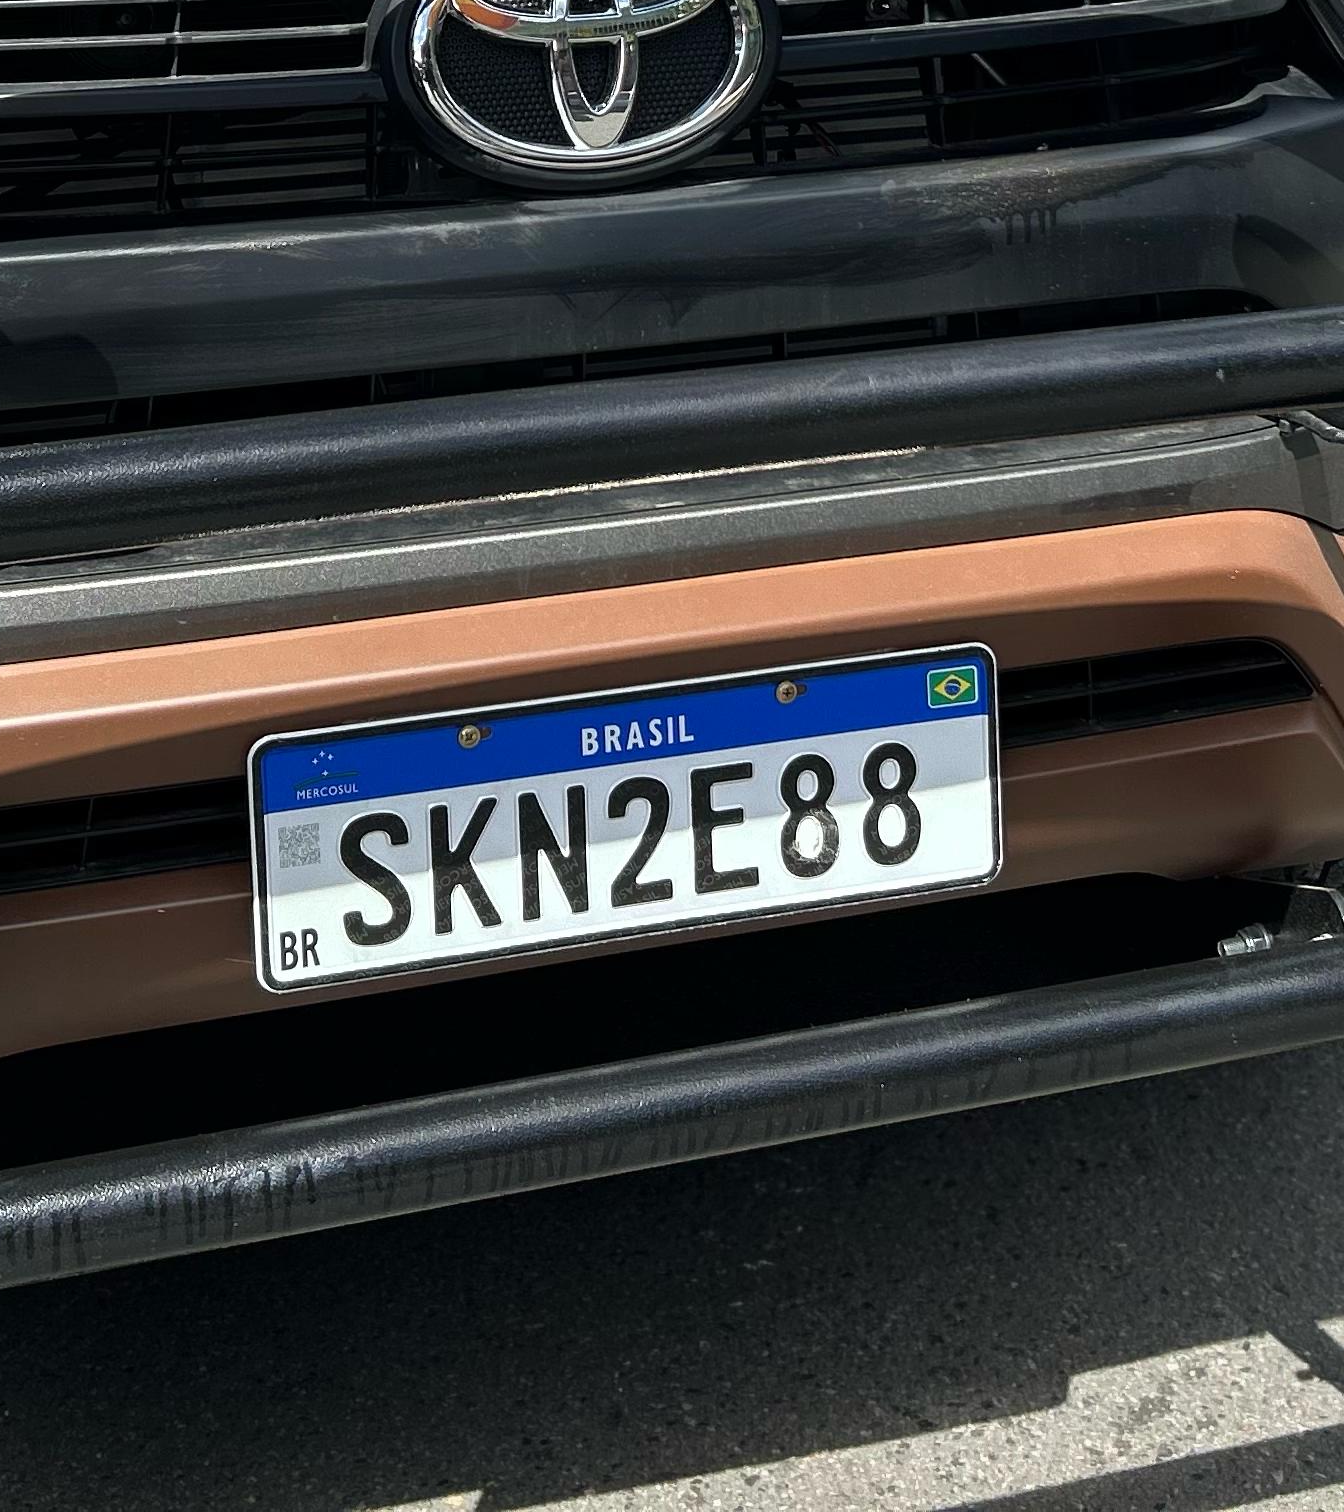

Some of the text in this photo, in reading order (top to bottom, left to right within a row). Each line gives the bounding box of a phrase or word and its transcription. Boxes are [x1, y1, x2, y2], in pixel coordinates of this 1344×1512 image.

[581, 714, 695, 757] BRASIL
[295, 782, 359, 801] MERCOSUL
[339, 740, 923, 947] SKN2E88
[279, 927, 321, 971] BR
